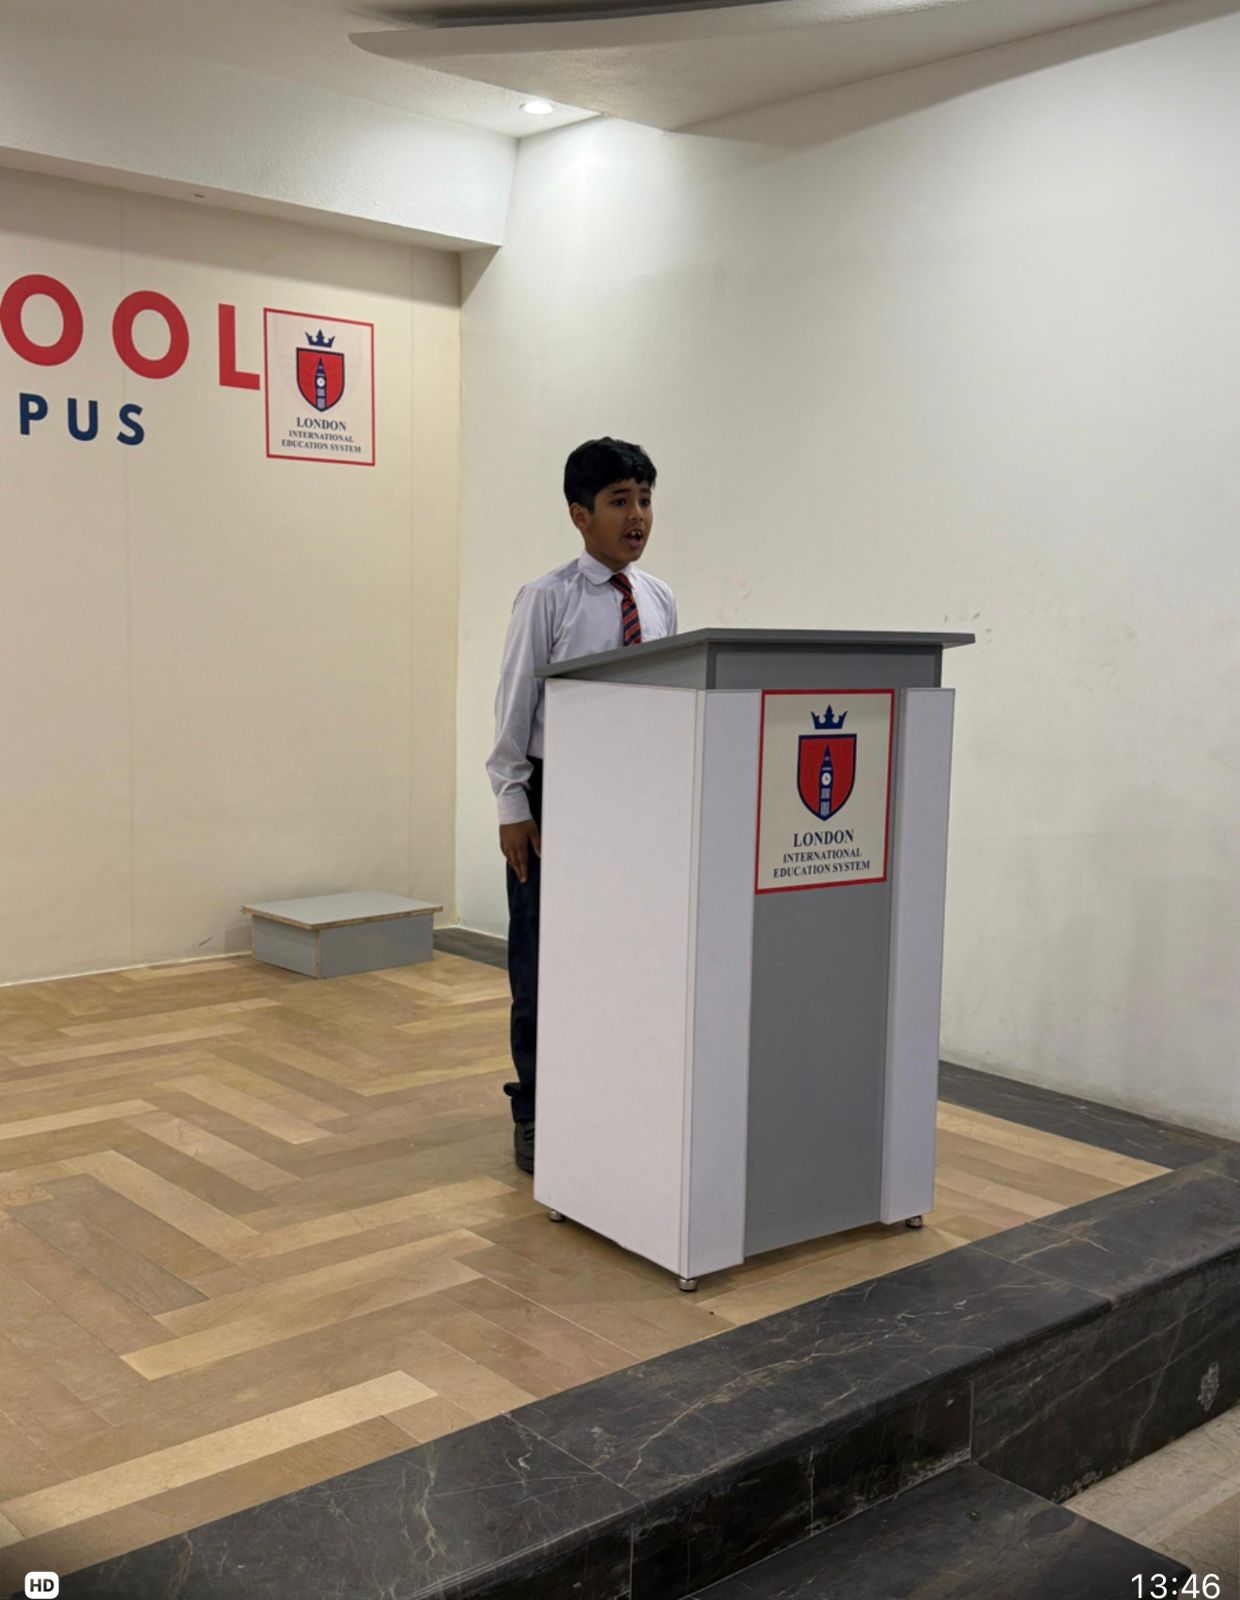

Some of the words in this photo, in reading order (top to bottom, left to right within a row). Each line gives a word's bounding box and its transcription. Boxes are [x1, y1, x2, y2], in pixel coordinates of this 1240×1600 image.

[0, 274, 260, 391] OOL
[19, 393, 145, 446] PUS
[296, 416, 346, 430] LONDON
[288, 430, 353, 442] INTERNATIONAL
[281, 439, 328, 449] EDUCATION
[330, 444, 361, 453] SYSTEM
[793, 829, 854, 847] LONDON
[783, 848, 862, 863] INTERNATIONAL
[773, 863, 830, 878] EDUCATION
[832, 860, 870, 873] SYSTEM
